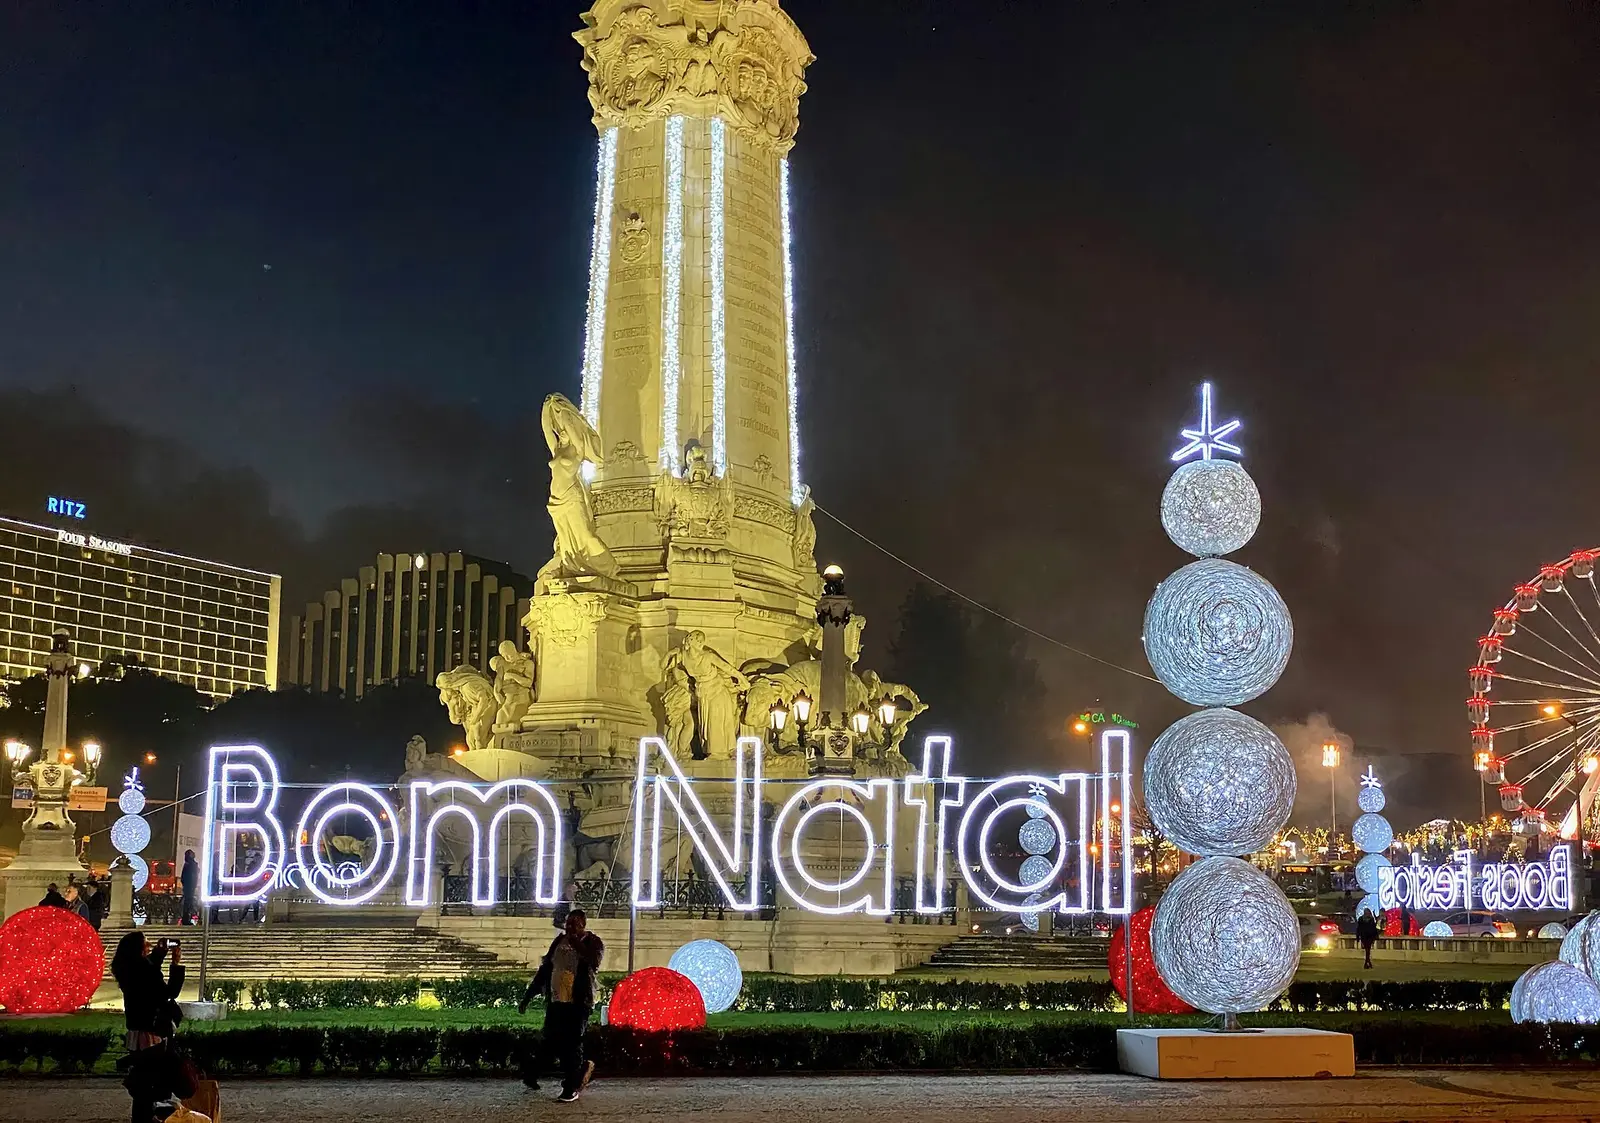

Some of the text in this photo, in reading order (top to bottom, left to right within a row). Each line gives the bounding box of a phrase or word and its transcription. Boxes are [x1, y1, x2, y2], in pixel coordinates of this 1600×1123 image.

[48, 496, 86, 519] RITZ
[201, 729, 1132, 916] Bom Natal
